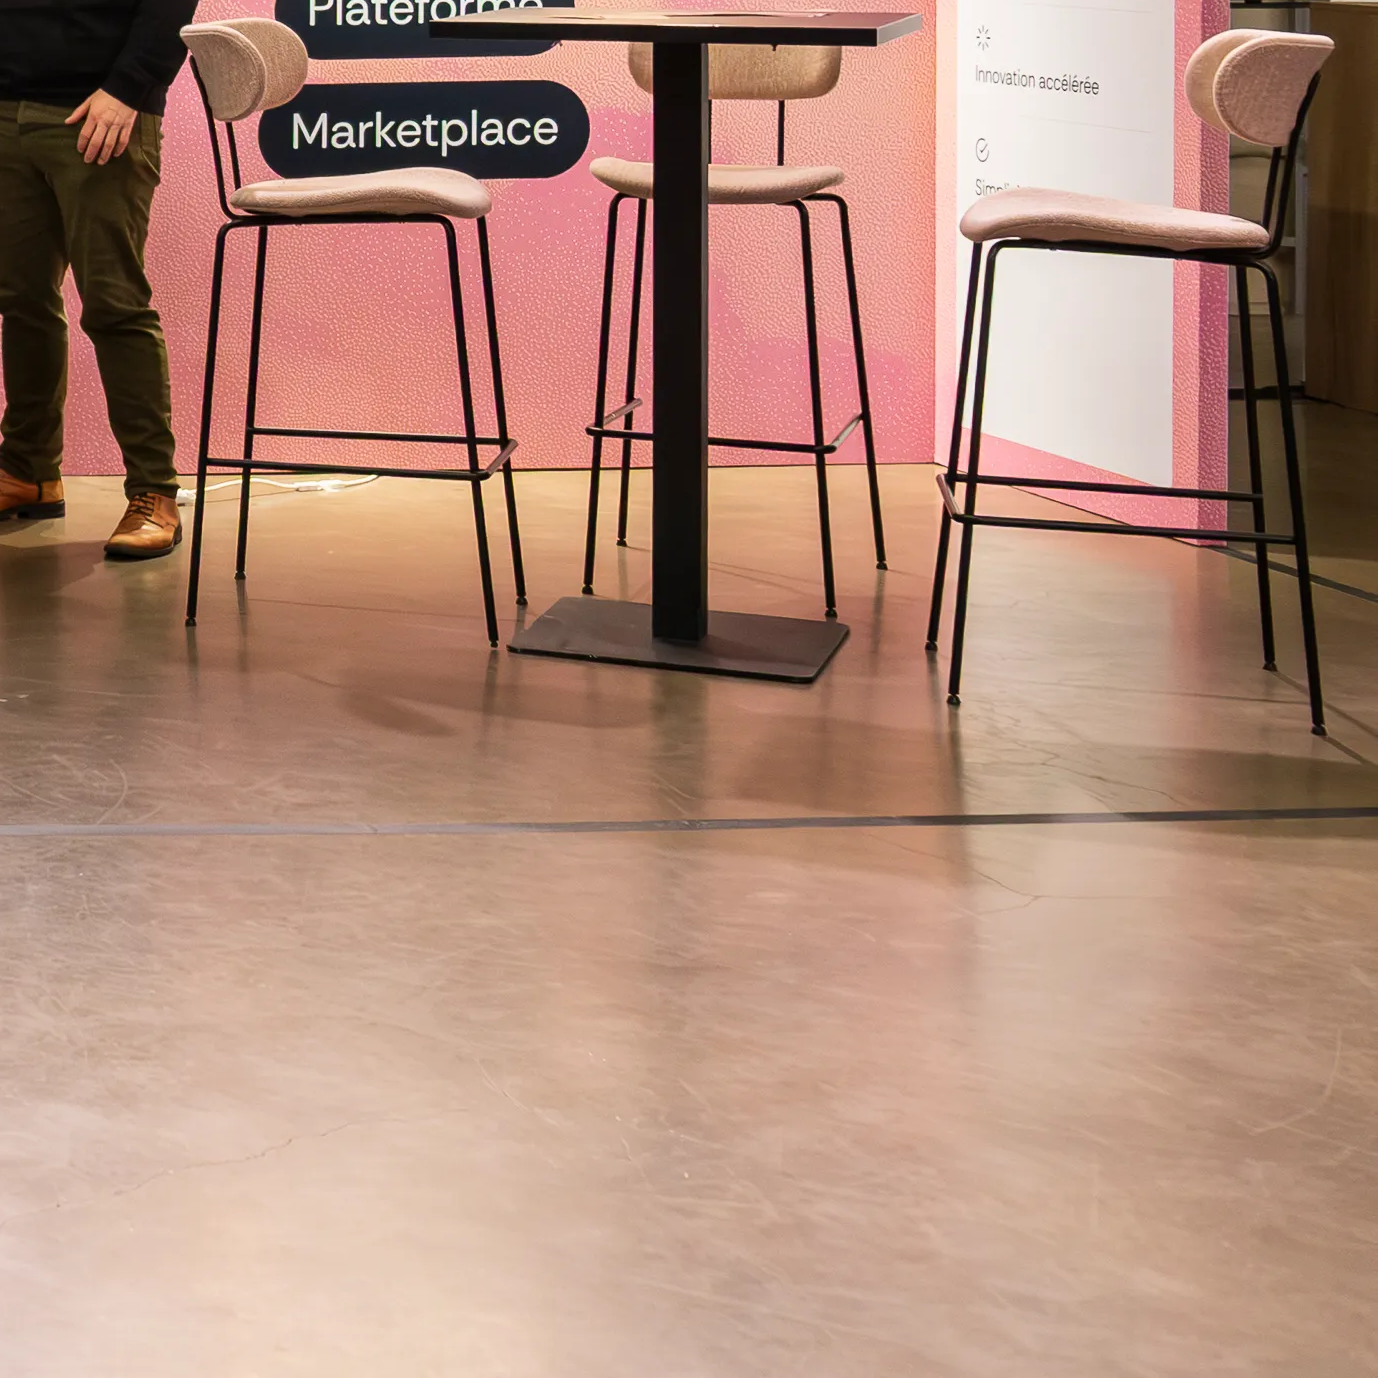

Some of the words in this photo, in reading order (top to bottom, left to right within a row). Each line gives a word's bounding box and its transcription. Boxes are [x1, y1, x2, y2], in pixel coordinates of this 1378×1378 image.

[976, 65, 1036, 89] Innovation
[1038, 72, 1100, 96] accélérée
[291, 109, 559, 158] Marketplace
